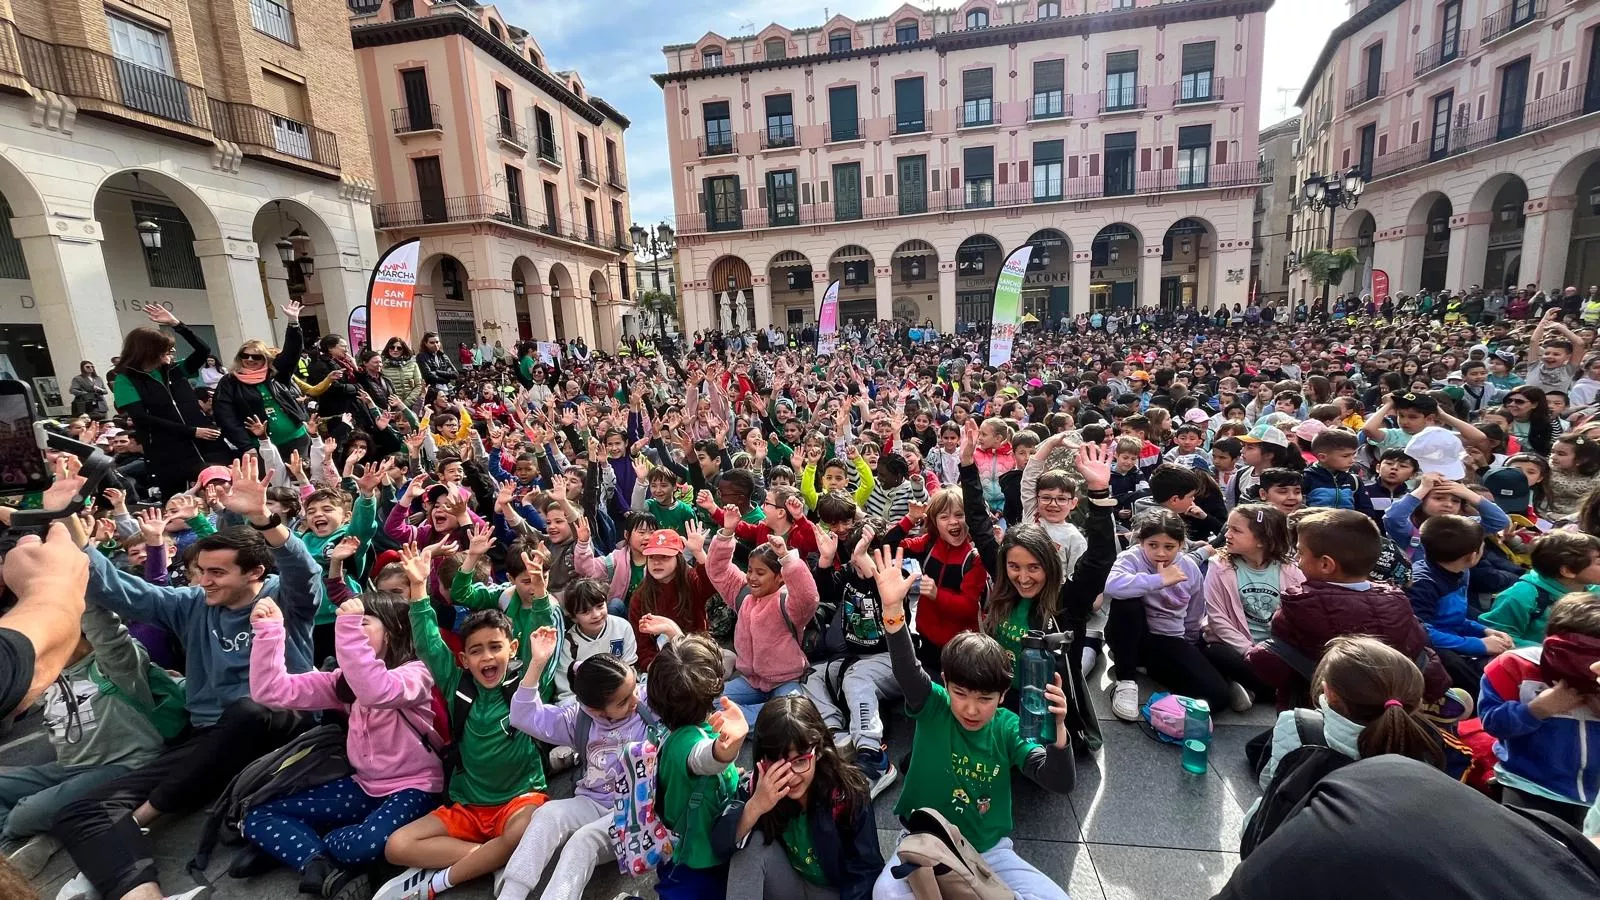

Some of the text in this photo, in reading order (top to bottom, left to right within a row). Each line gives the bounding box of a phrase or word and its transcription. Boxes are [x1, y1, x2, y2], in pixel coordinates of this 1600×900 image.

[384, 262, 408, 271] MINI
[1004, 264, 1025, 274] MARCHA
[378, 270, 415, 279] MARCHA
[384, 289, 404, 298] SAN
[976, 762, 989, 774] EL
